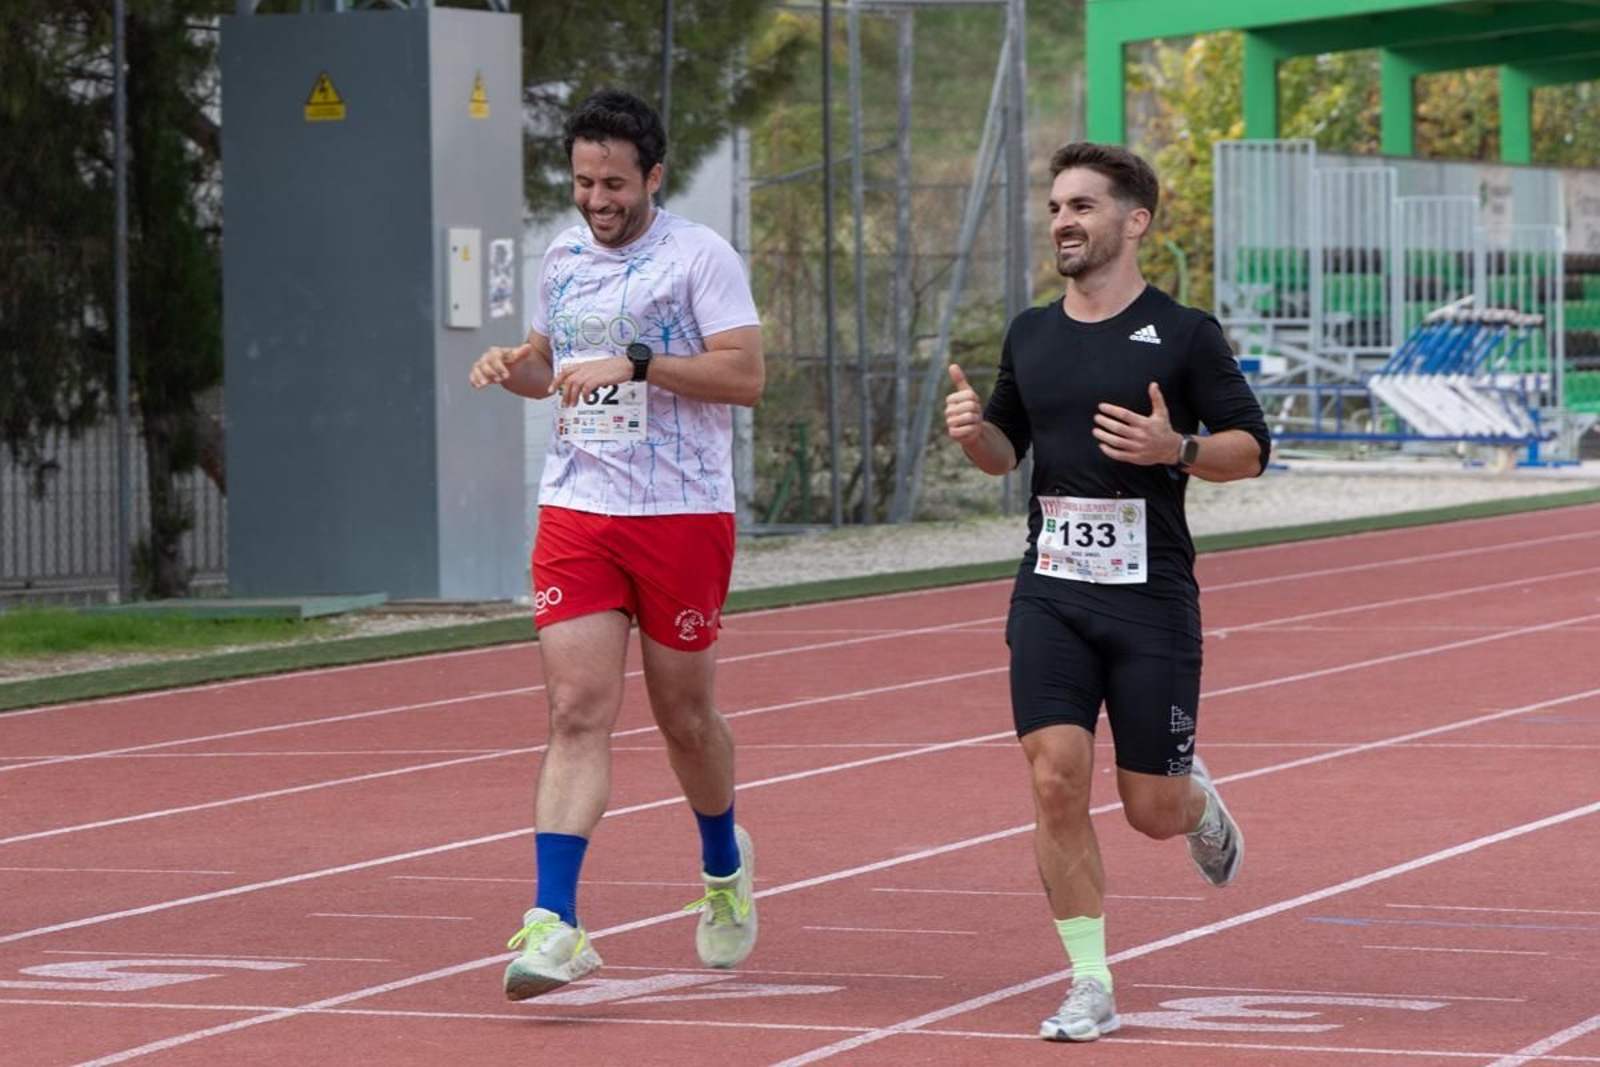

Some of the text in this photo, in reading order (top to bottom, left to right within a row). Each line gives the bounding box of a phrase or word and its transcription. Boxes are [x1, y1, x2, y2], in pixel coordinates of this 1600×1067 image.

[1129, 334, 1162, 344] adidas
[1059, 521, 1117, 548] 133
[1119, 995, 1451, 1033] 3
